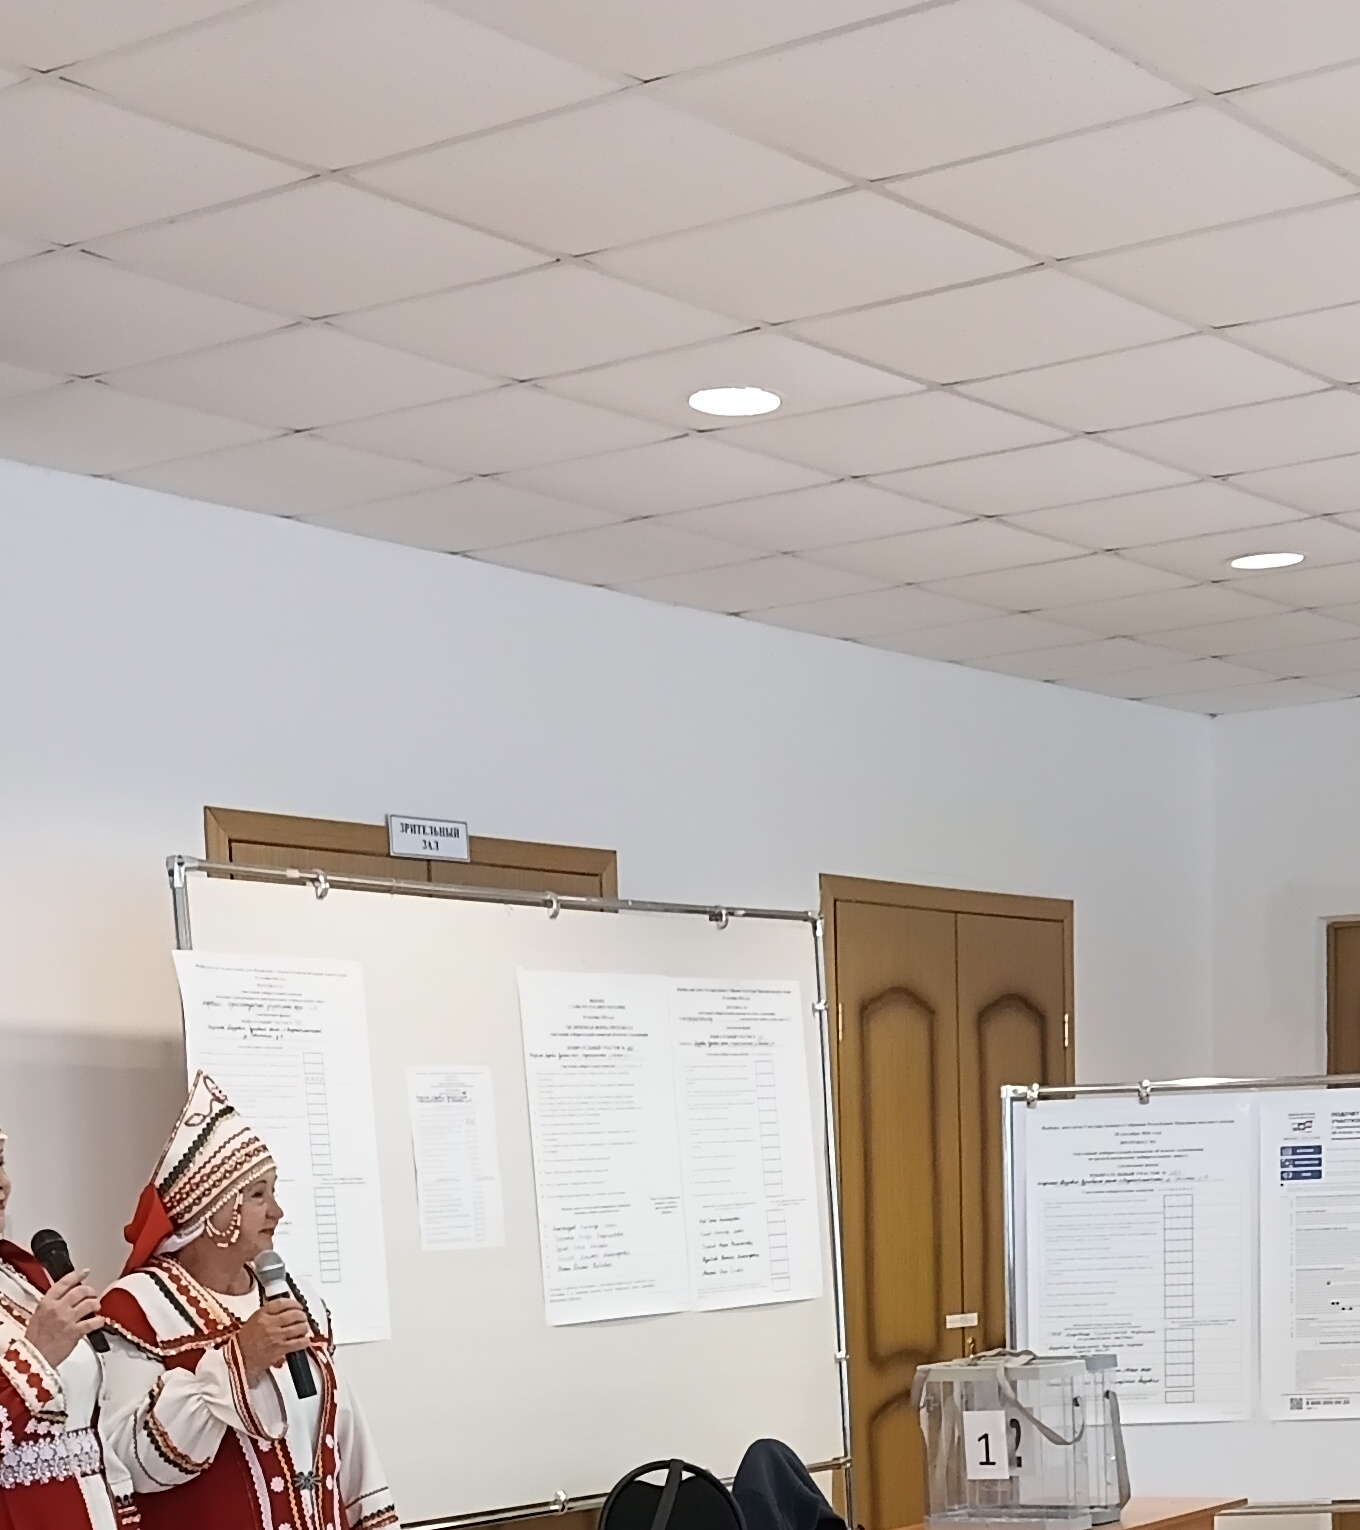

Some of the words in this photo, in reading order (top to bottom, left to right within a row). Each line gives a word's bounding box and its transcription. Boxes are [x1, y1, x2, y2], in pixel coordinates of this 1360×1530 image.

[400, 822, 460, 839] ЗРИТЕЛЬНЫЙ
[422, 839, 440, 852] ЗАЛ
[977, 1432, 997, 1466] 1
